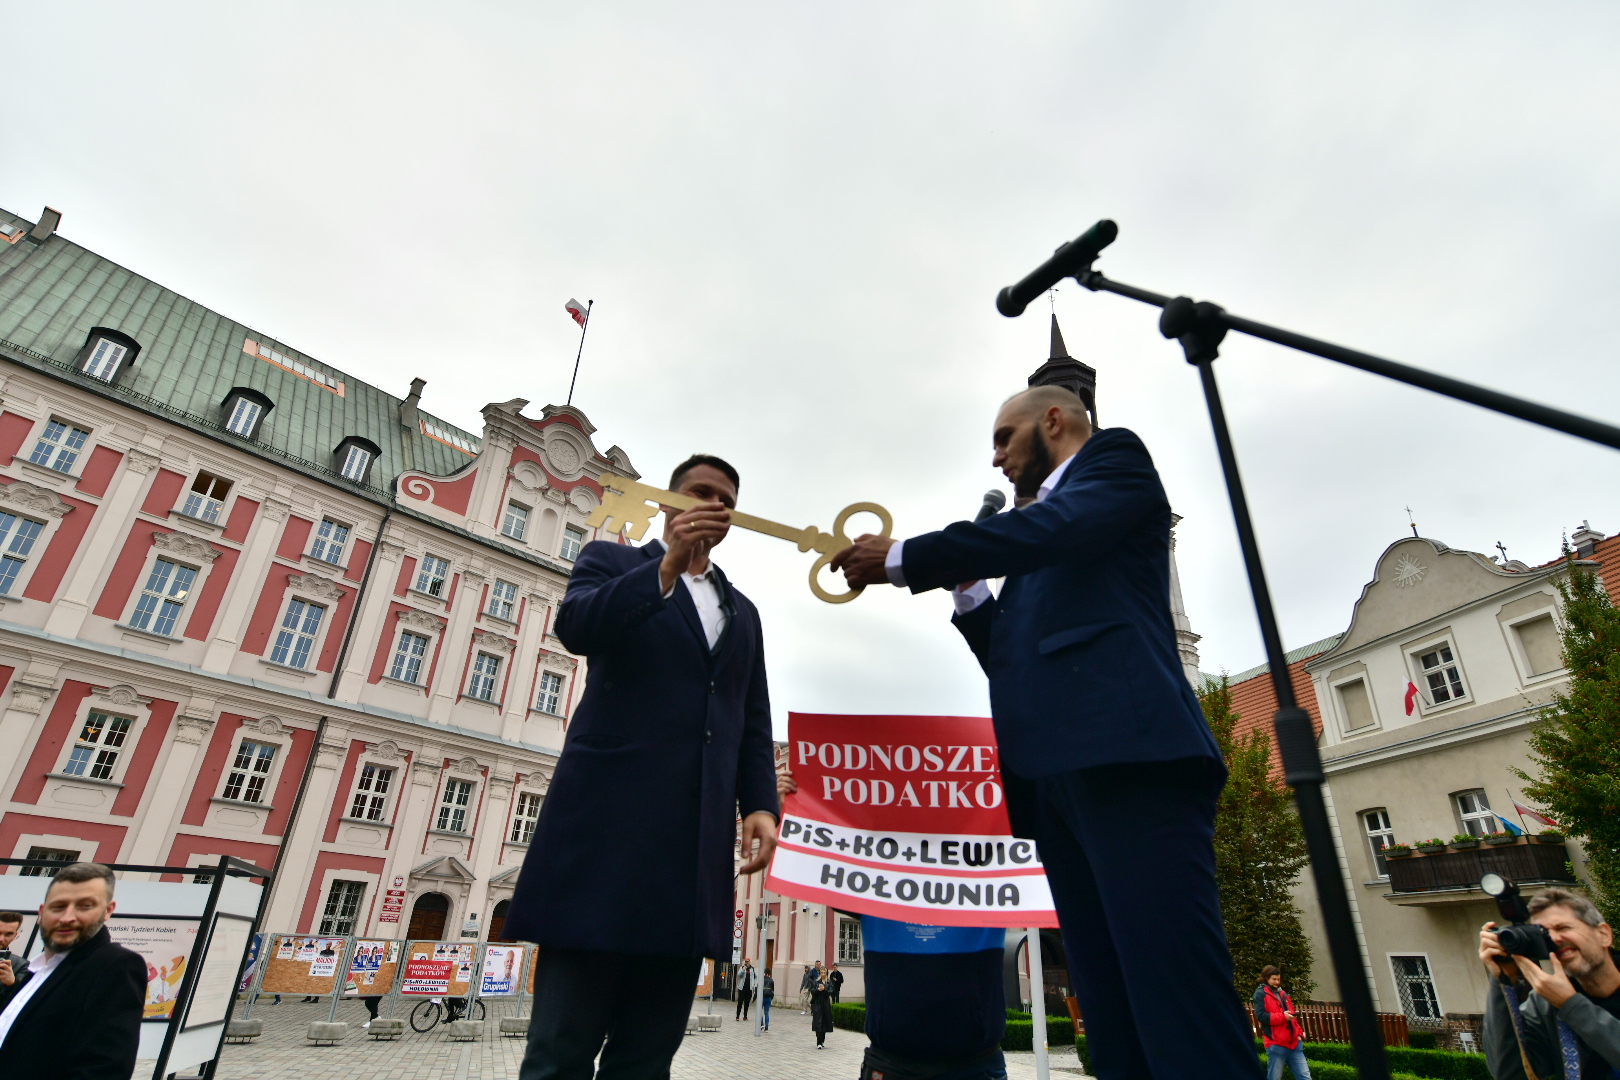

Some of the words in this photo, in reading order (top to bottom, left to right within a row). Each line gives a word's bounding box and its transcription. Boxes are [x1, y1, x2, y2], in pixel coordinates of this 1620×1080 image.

[796, 740, 1001, 774] PODNOSZE
[822, 774, 1003, 809] PODATKÓ
[820, 864, 1020, 906] HOŁOWNIA
[131, 925, 155, 934] Tydzień
